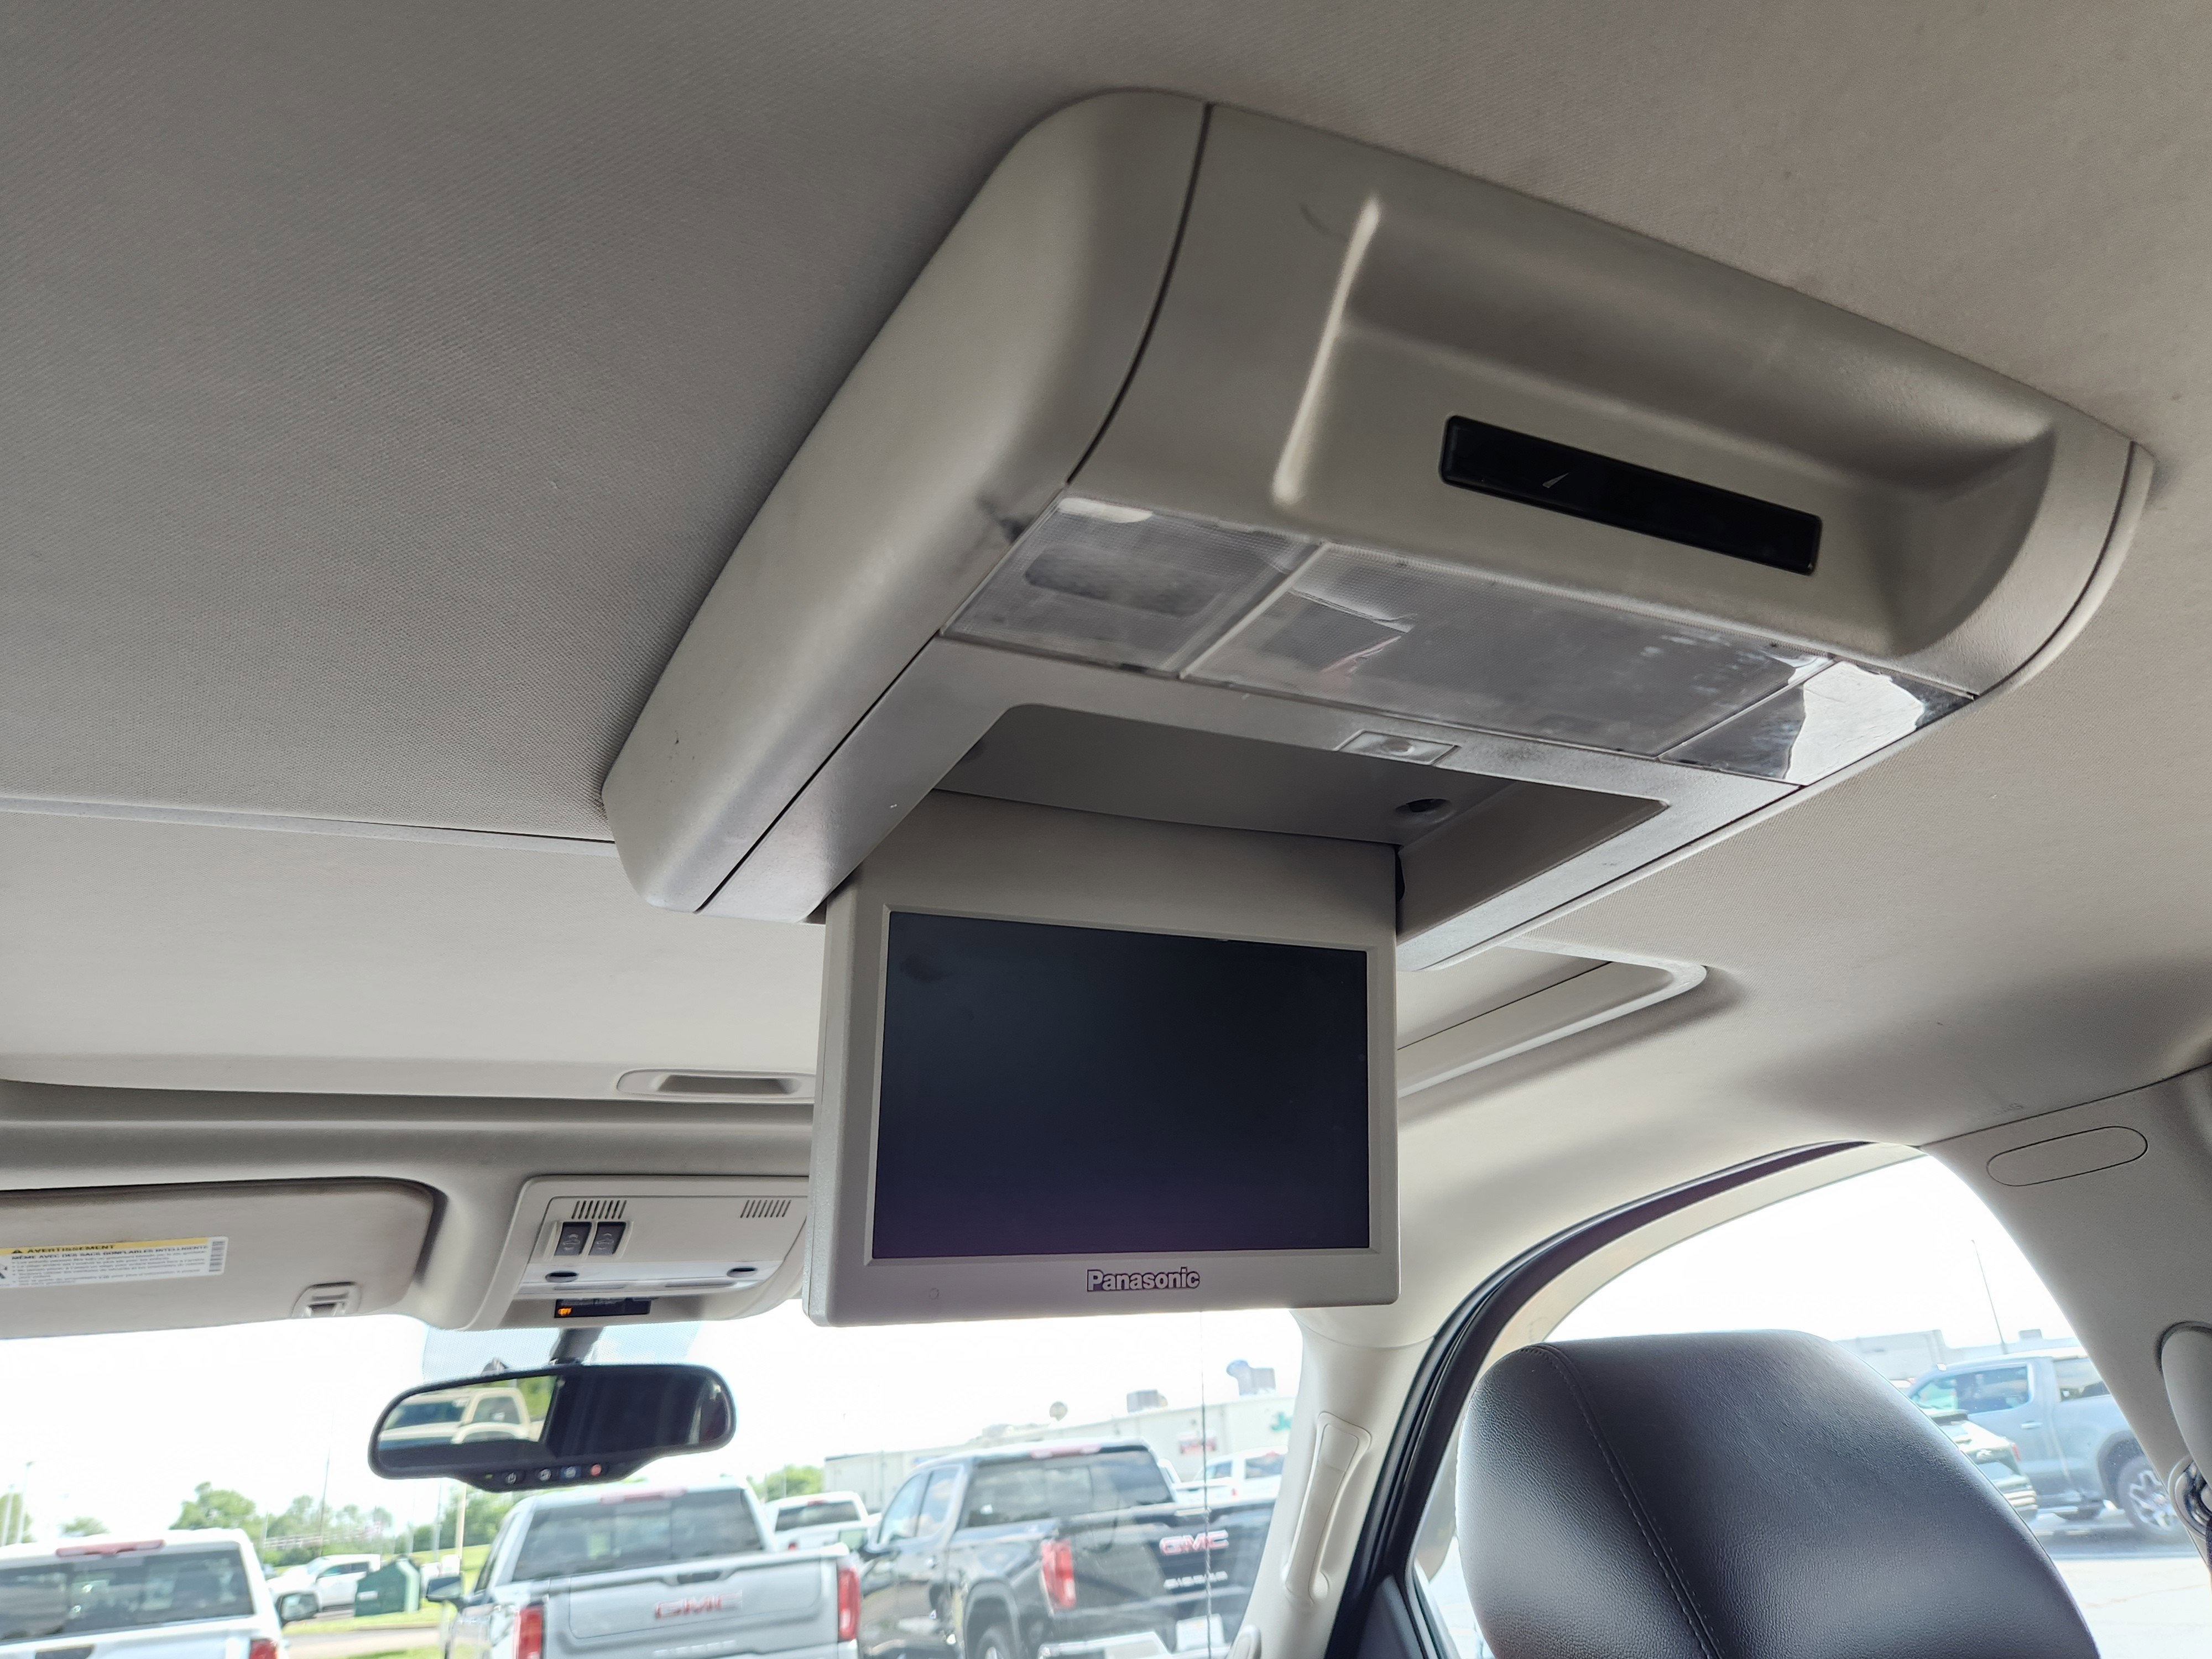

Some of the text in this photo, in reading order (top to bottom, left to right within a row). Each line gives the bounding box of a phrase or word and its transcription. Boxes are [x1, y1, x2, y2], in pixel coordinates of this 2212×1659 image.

[27, 1244, 114, 1254] AVERTISSEMENT
[1087, 1266, 1201, 1292] Panasonic
[1159, 1530, 1229, 1556] GMC
[654, 1590, 743, 1620] GMC
